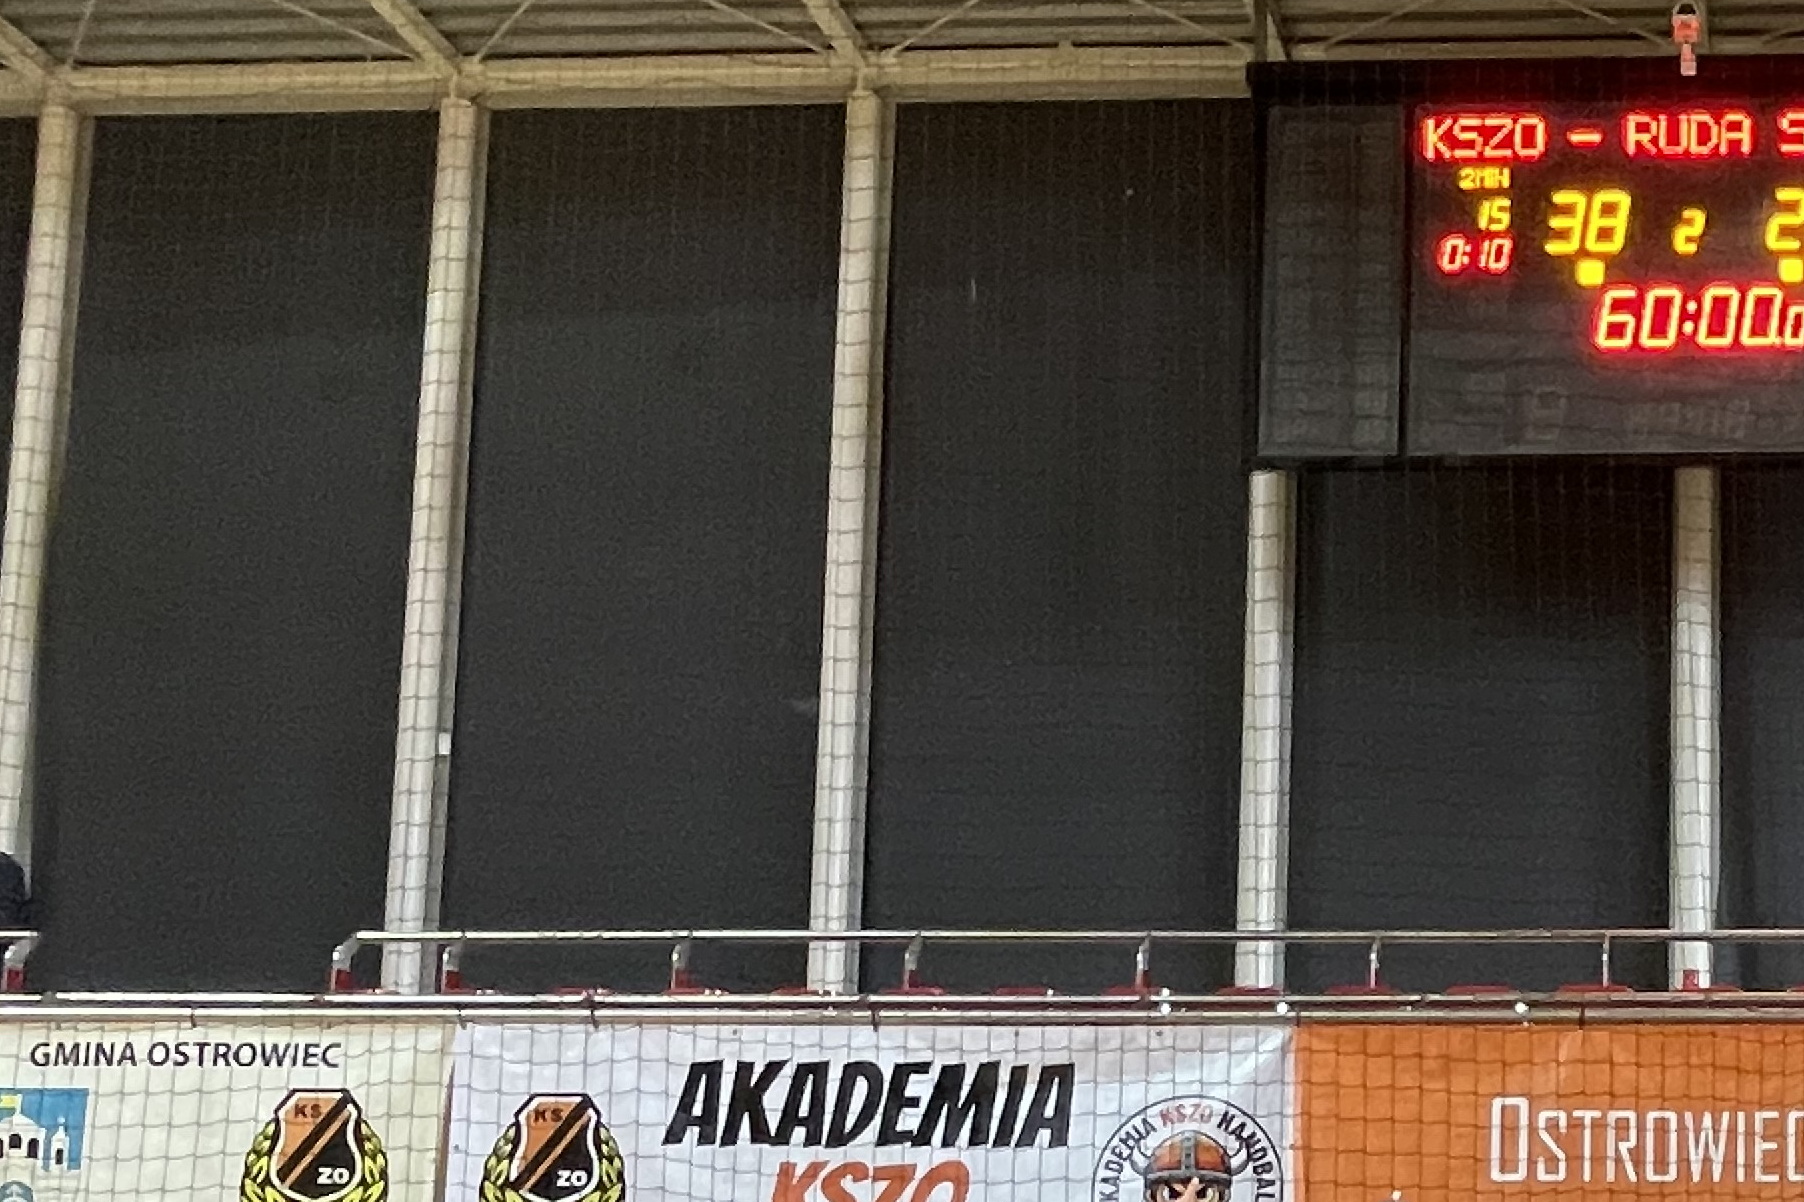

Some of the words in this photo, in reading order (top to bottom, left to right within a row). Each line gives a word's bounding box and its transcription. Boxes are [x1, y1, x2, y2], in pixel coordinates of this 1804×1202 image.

[1422, 114, 1546, 161] KSZO
[1626, 112, 1753, 156] RUDA
[1477, 196, 1512, 231] 15
[1545, 189, 1632, 254] 38
[1673, 207, 1707, 254] 2
[1438, 236, 1514, 276] 0:10
[30, 1042, 137, 1068] GMINA
[147, 1041, 343, 1069] OSTROWIEC
[294, 1103, 322, 1119] KS
[533, 1108, 565, 1123] KS
[662, 1058, 1075, 1148] AKADEMIA
[1159, 1103, 1215, 1128] KSZO
[316, 1167, 350, 1185] ZO
[556, 1169, 588, 1187] ZO
